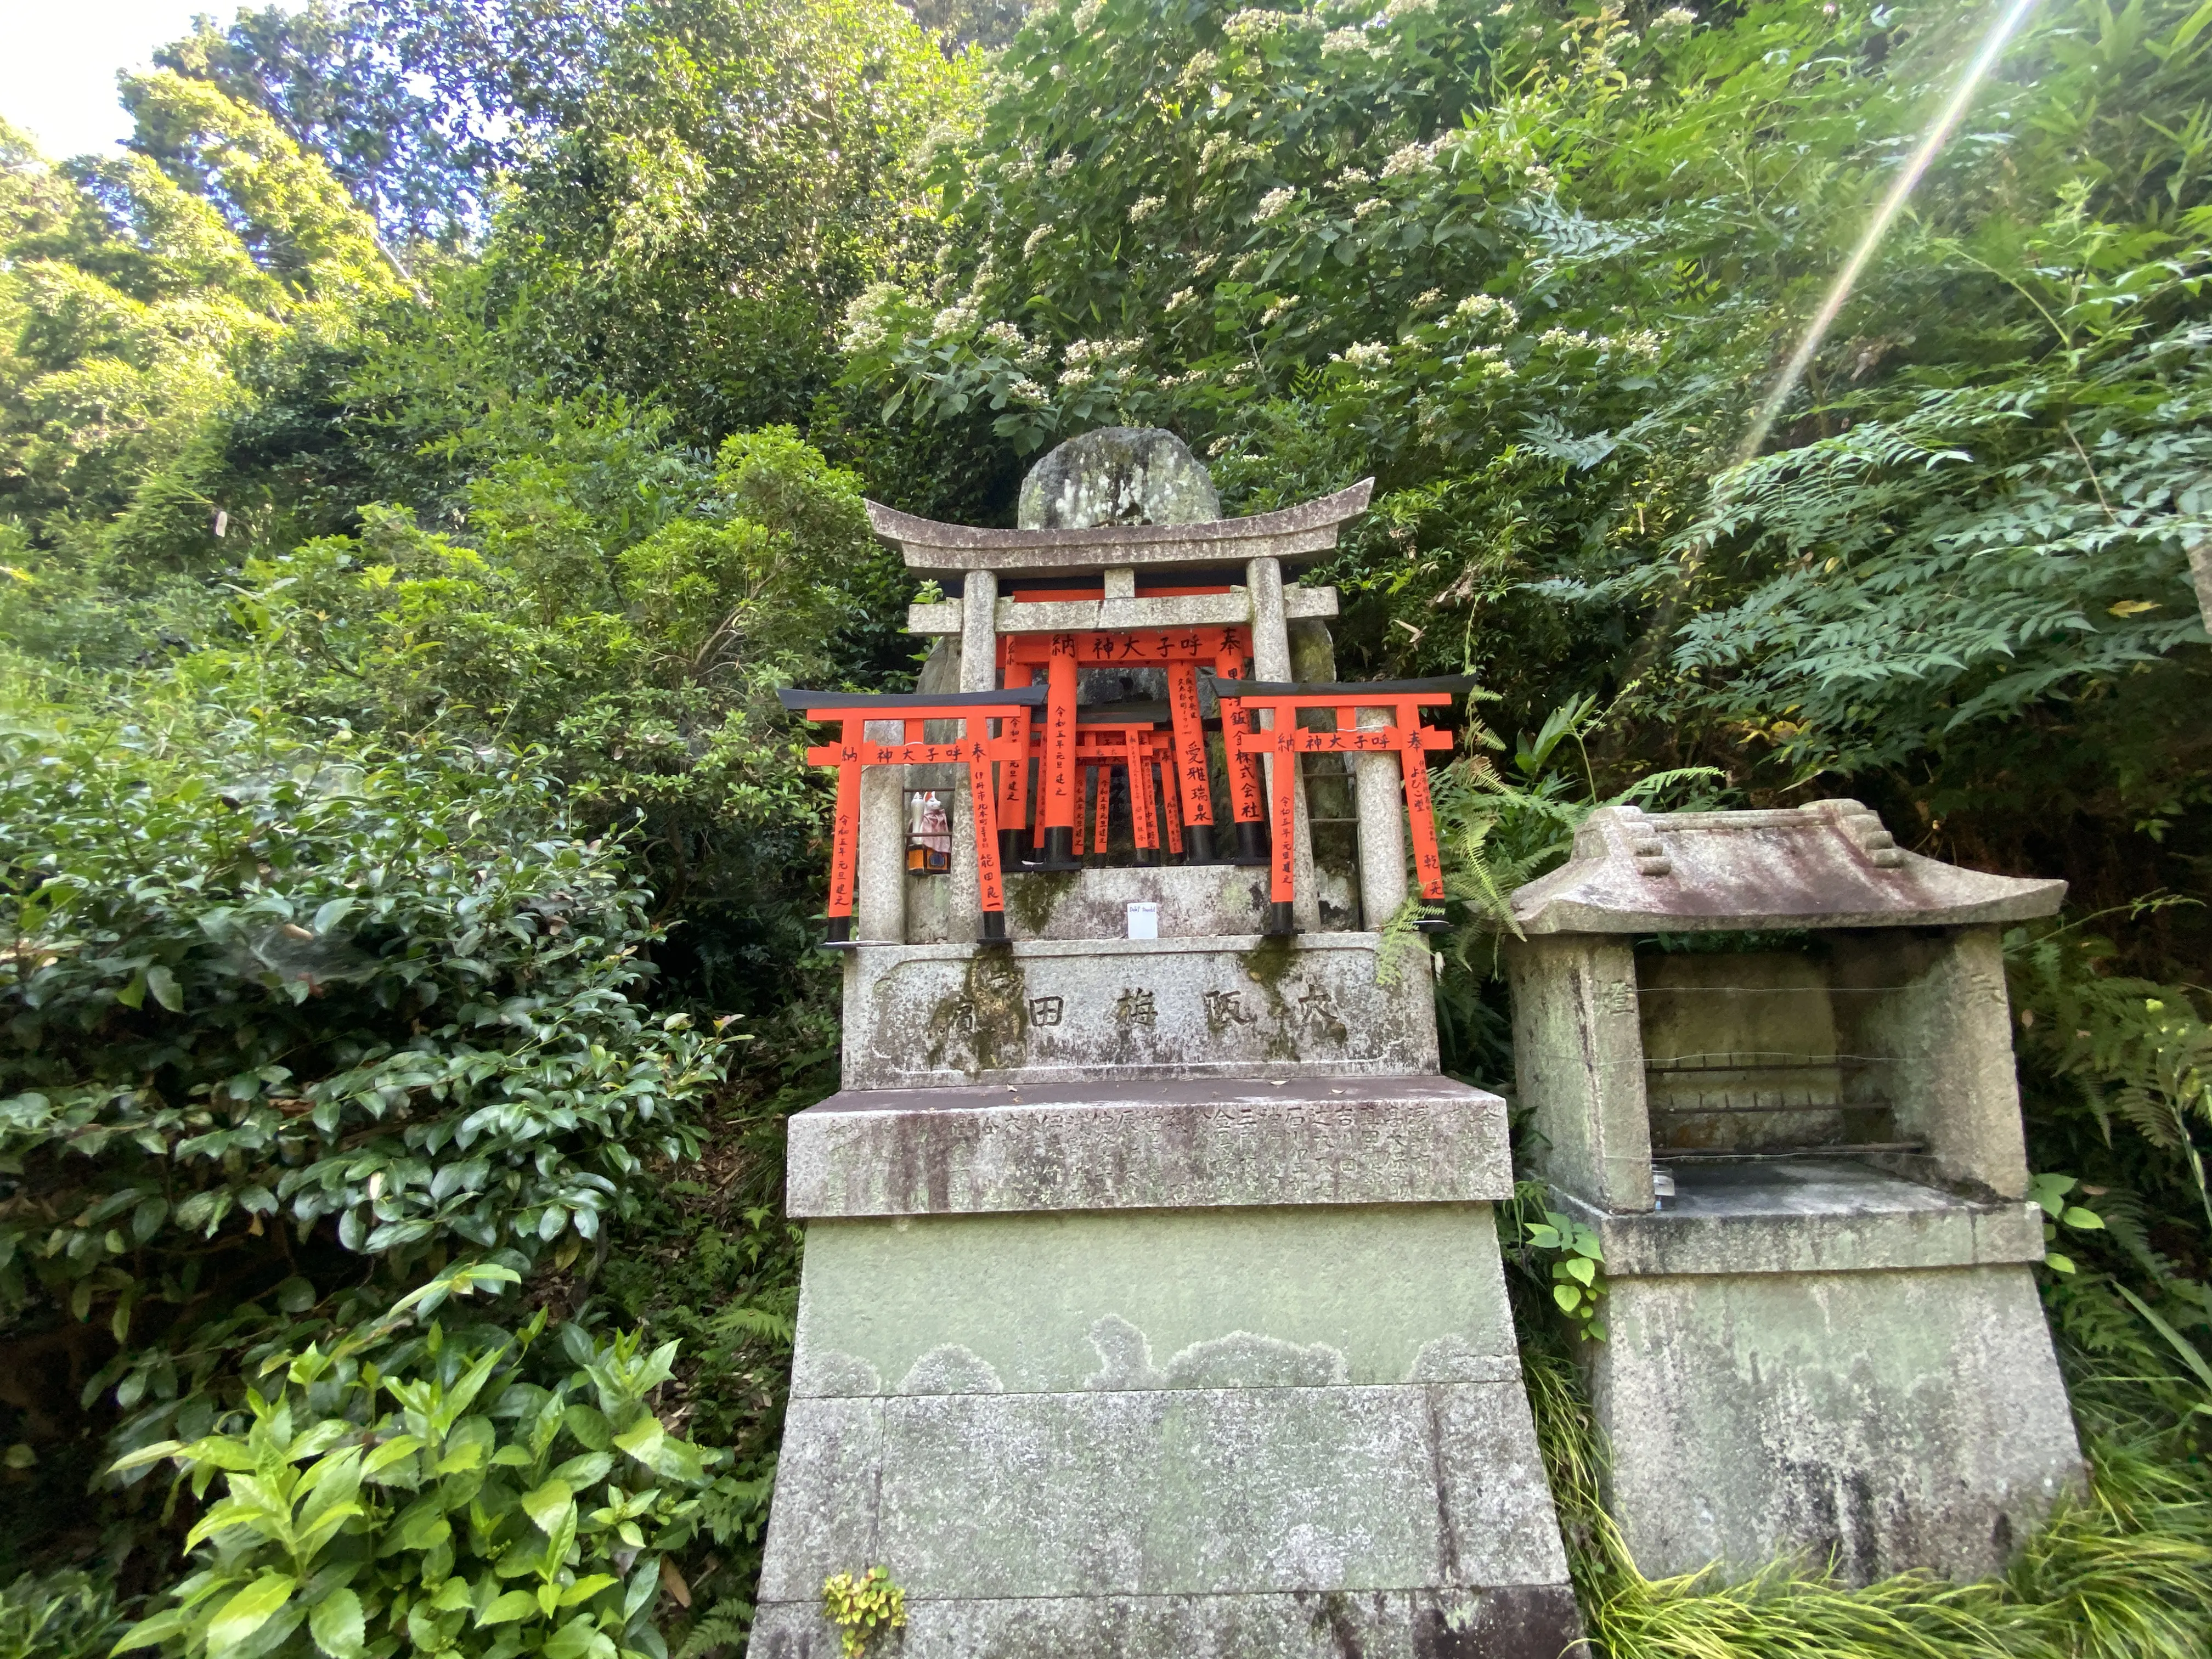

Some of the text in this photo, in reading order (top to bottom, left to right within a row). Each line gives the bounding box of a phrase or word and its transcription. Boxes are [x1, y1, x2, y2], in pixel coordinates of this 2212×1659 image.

[834, 814, 851, 906] 令和五年元旦建之
